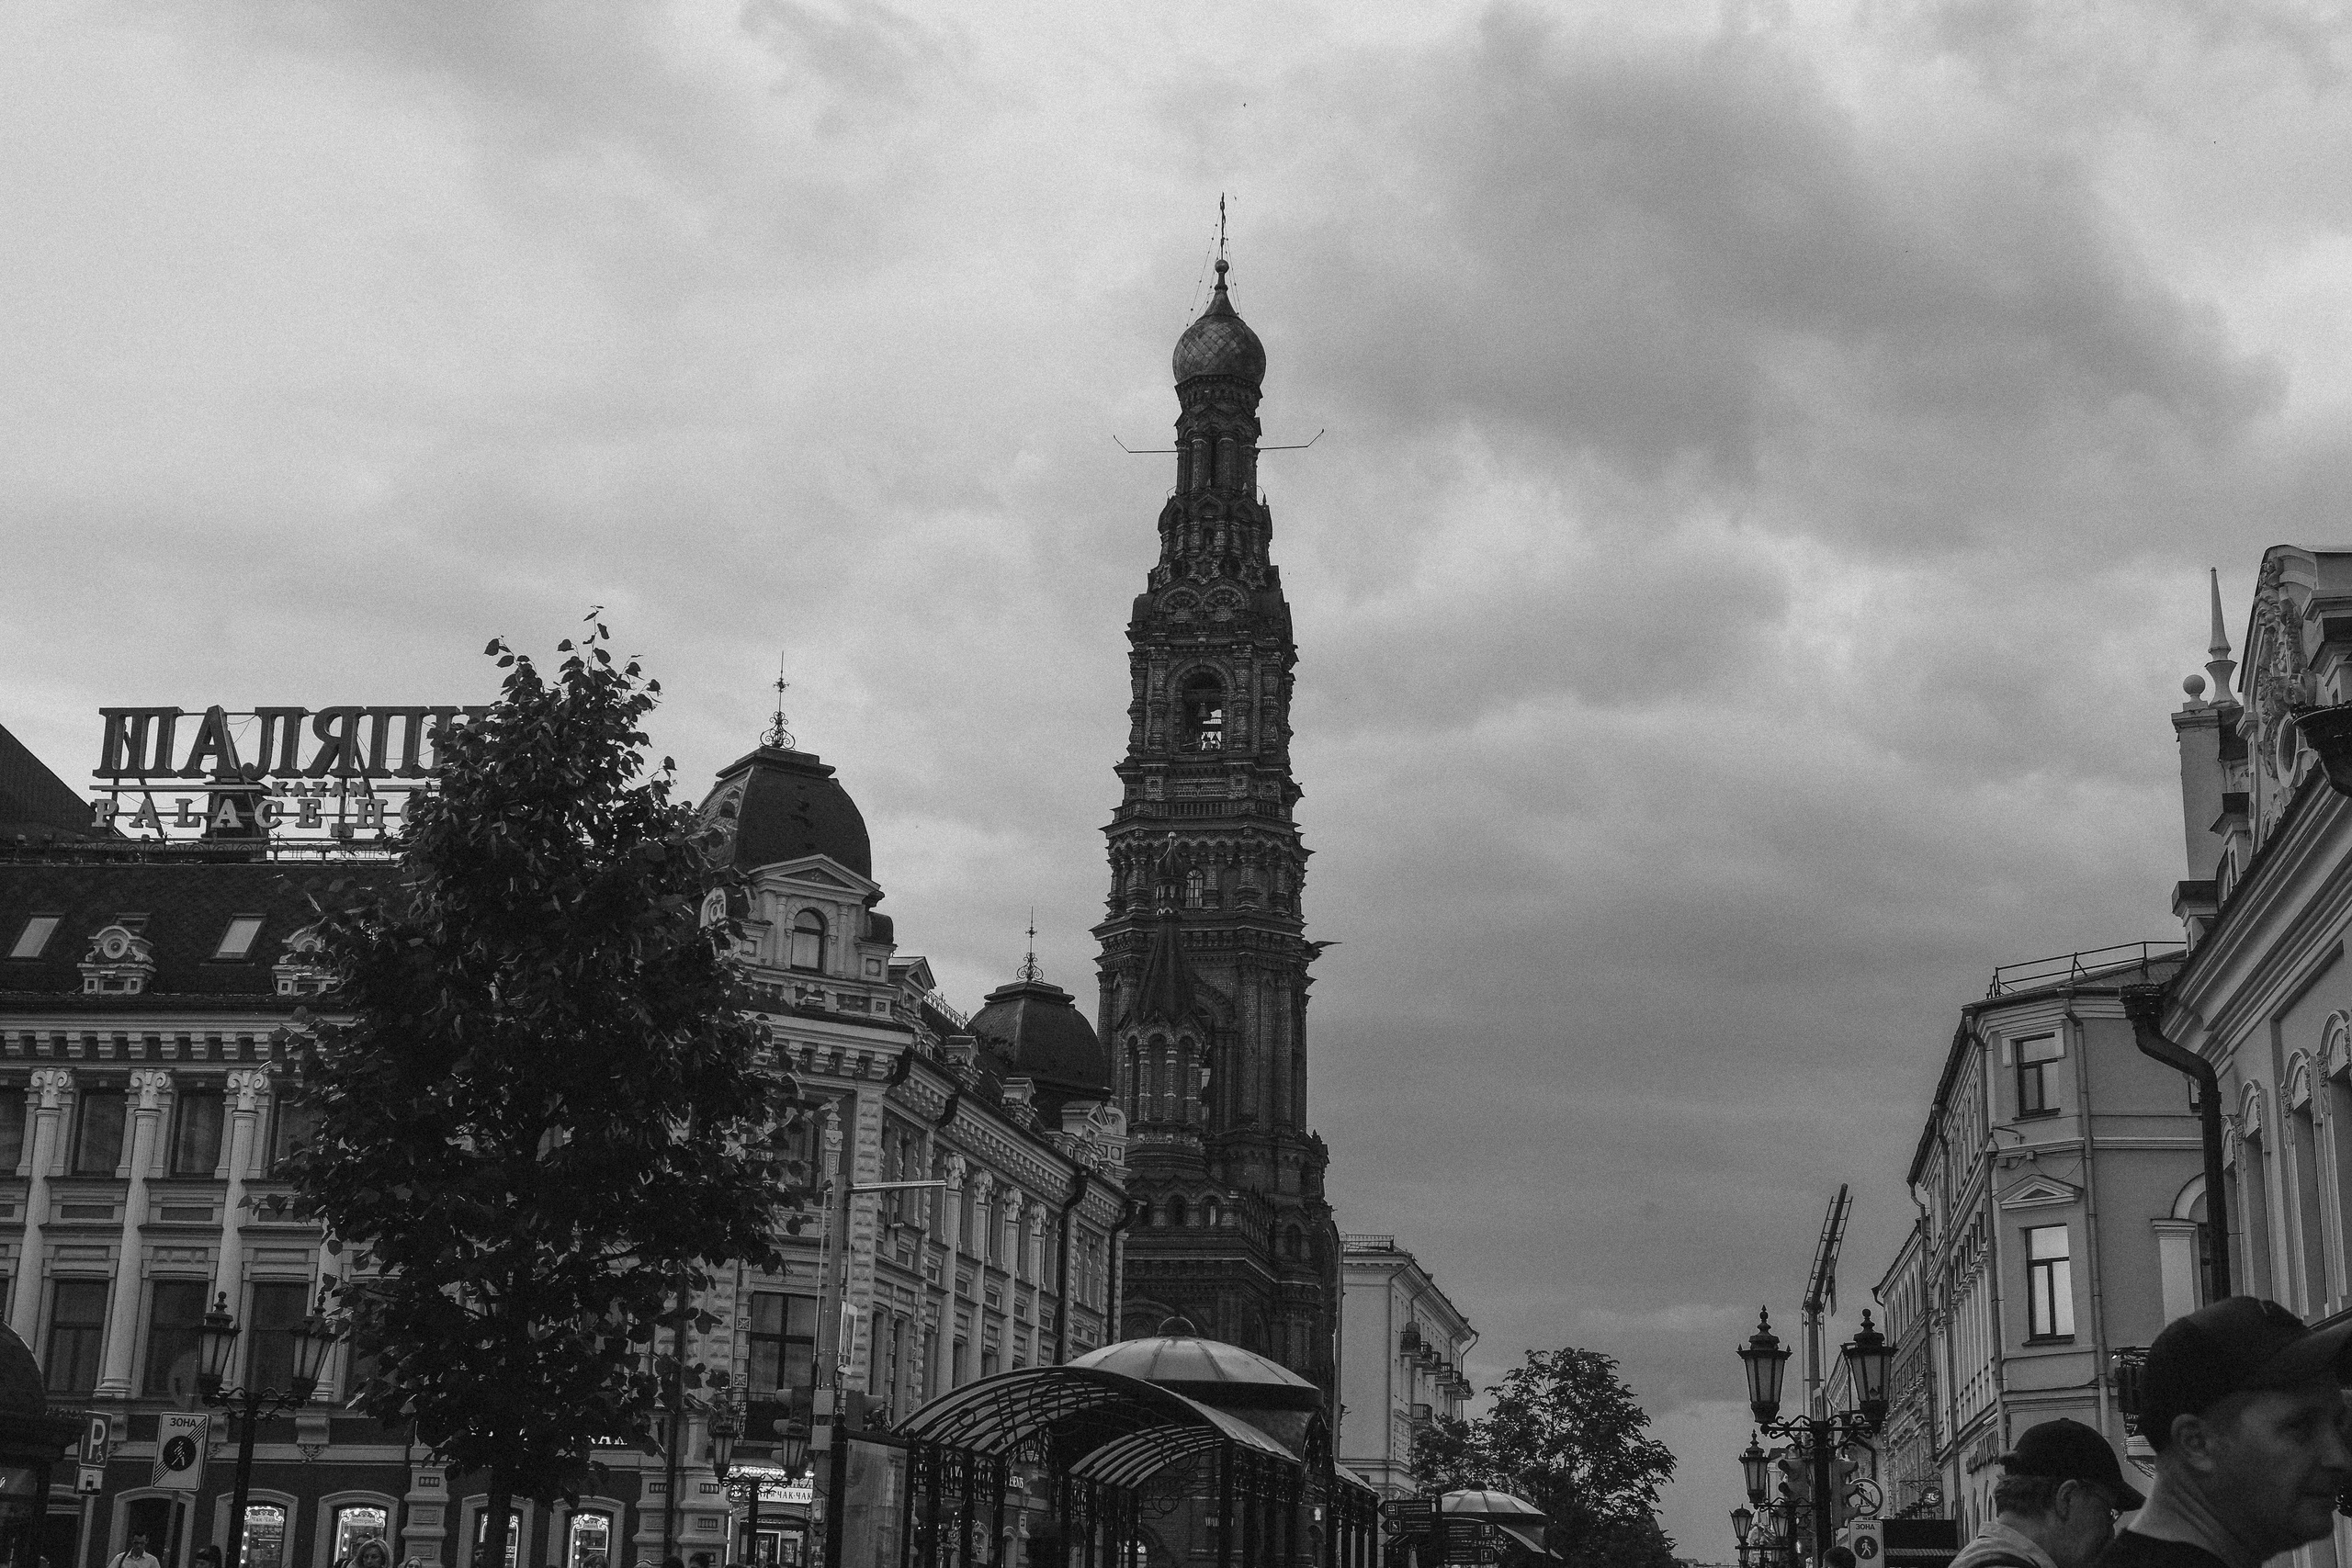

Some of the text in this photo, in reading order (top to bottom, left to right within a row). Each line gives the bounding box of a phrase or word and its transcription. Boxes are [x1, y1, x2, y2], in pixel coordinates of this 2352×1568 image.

[271, 781, 367, 797] KAZAN
[92, 797, 322, 829] PALACE
[169, 1417, 197, 1428] ЗОНА
